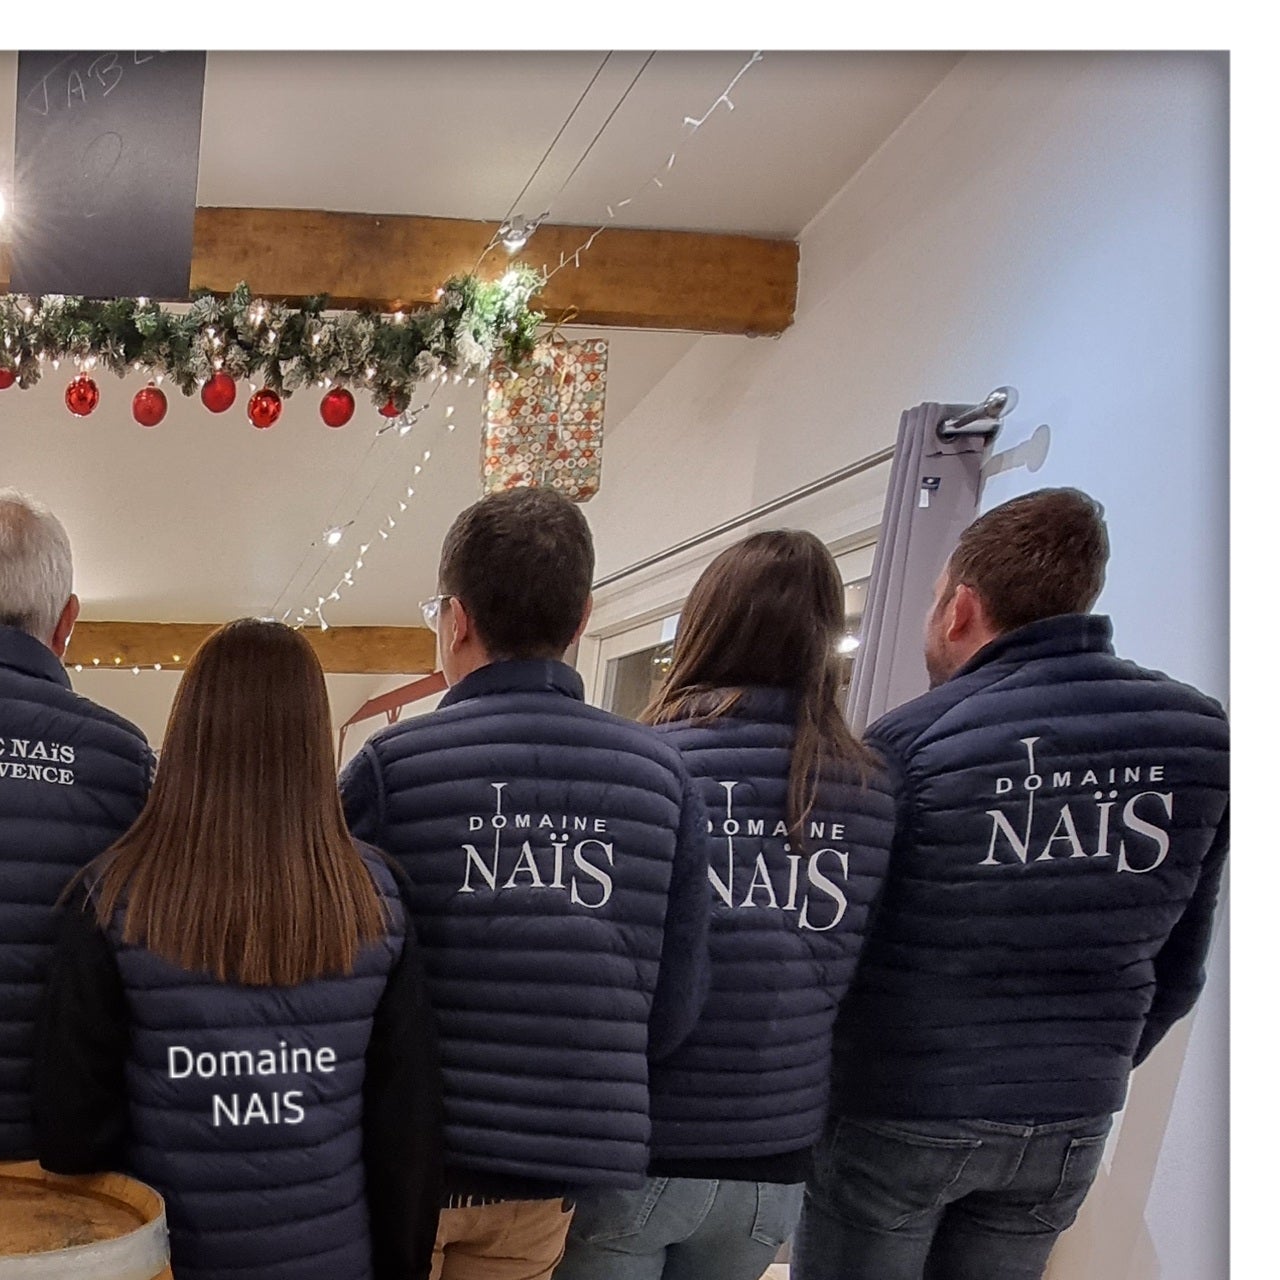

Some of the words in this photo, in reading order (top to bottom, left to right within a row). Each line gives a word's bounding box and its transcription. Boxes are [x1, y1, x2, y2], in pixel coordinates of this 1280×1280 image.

[995, 765, 1165, 794] DOMAINE
[469, 814, 607, 832] DOMAINE
[707, 819, 846, 840] OMANE
[977, 790, 1174, 874] NAÏS
[457, 832, 614, 908] NAÏS
[167, 1040, 337, 1079] Domaine
[212, 1090, 306, 1127] NAIS
